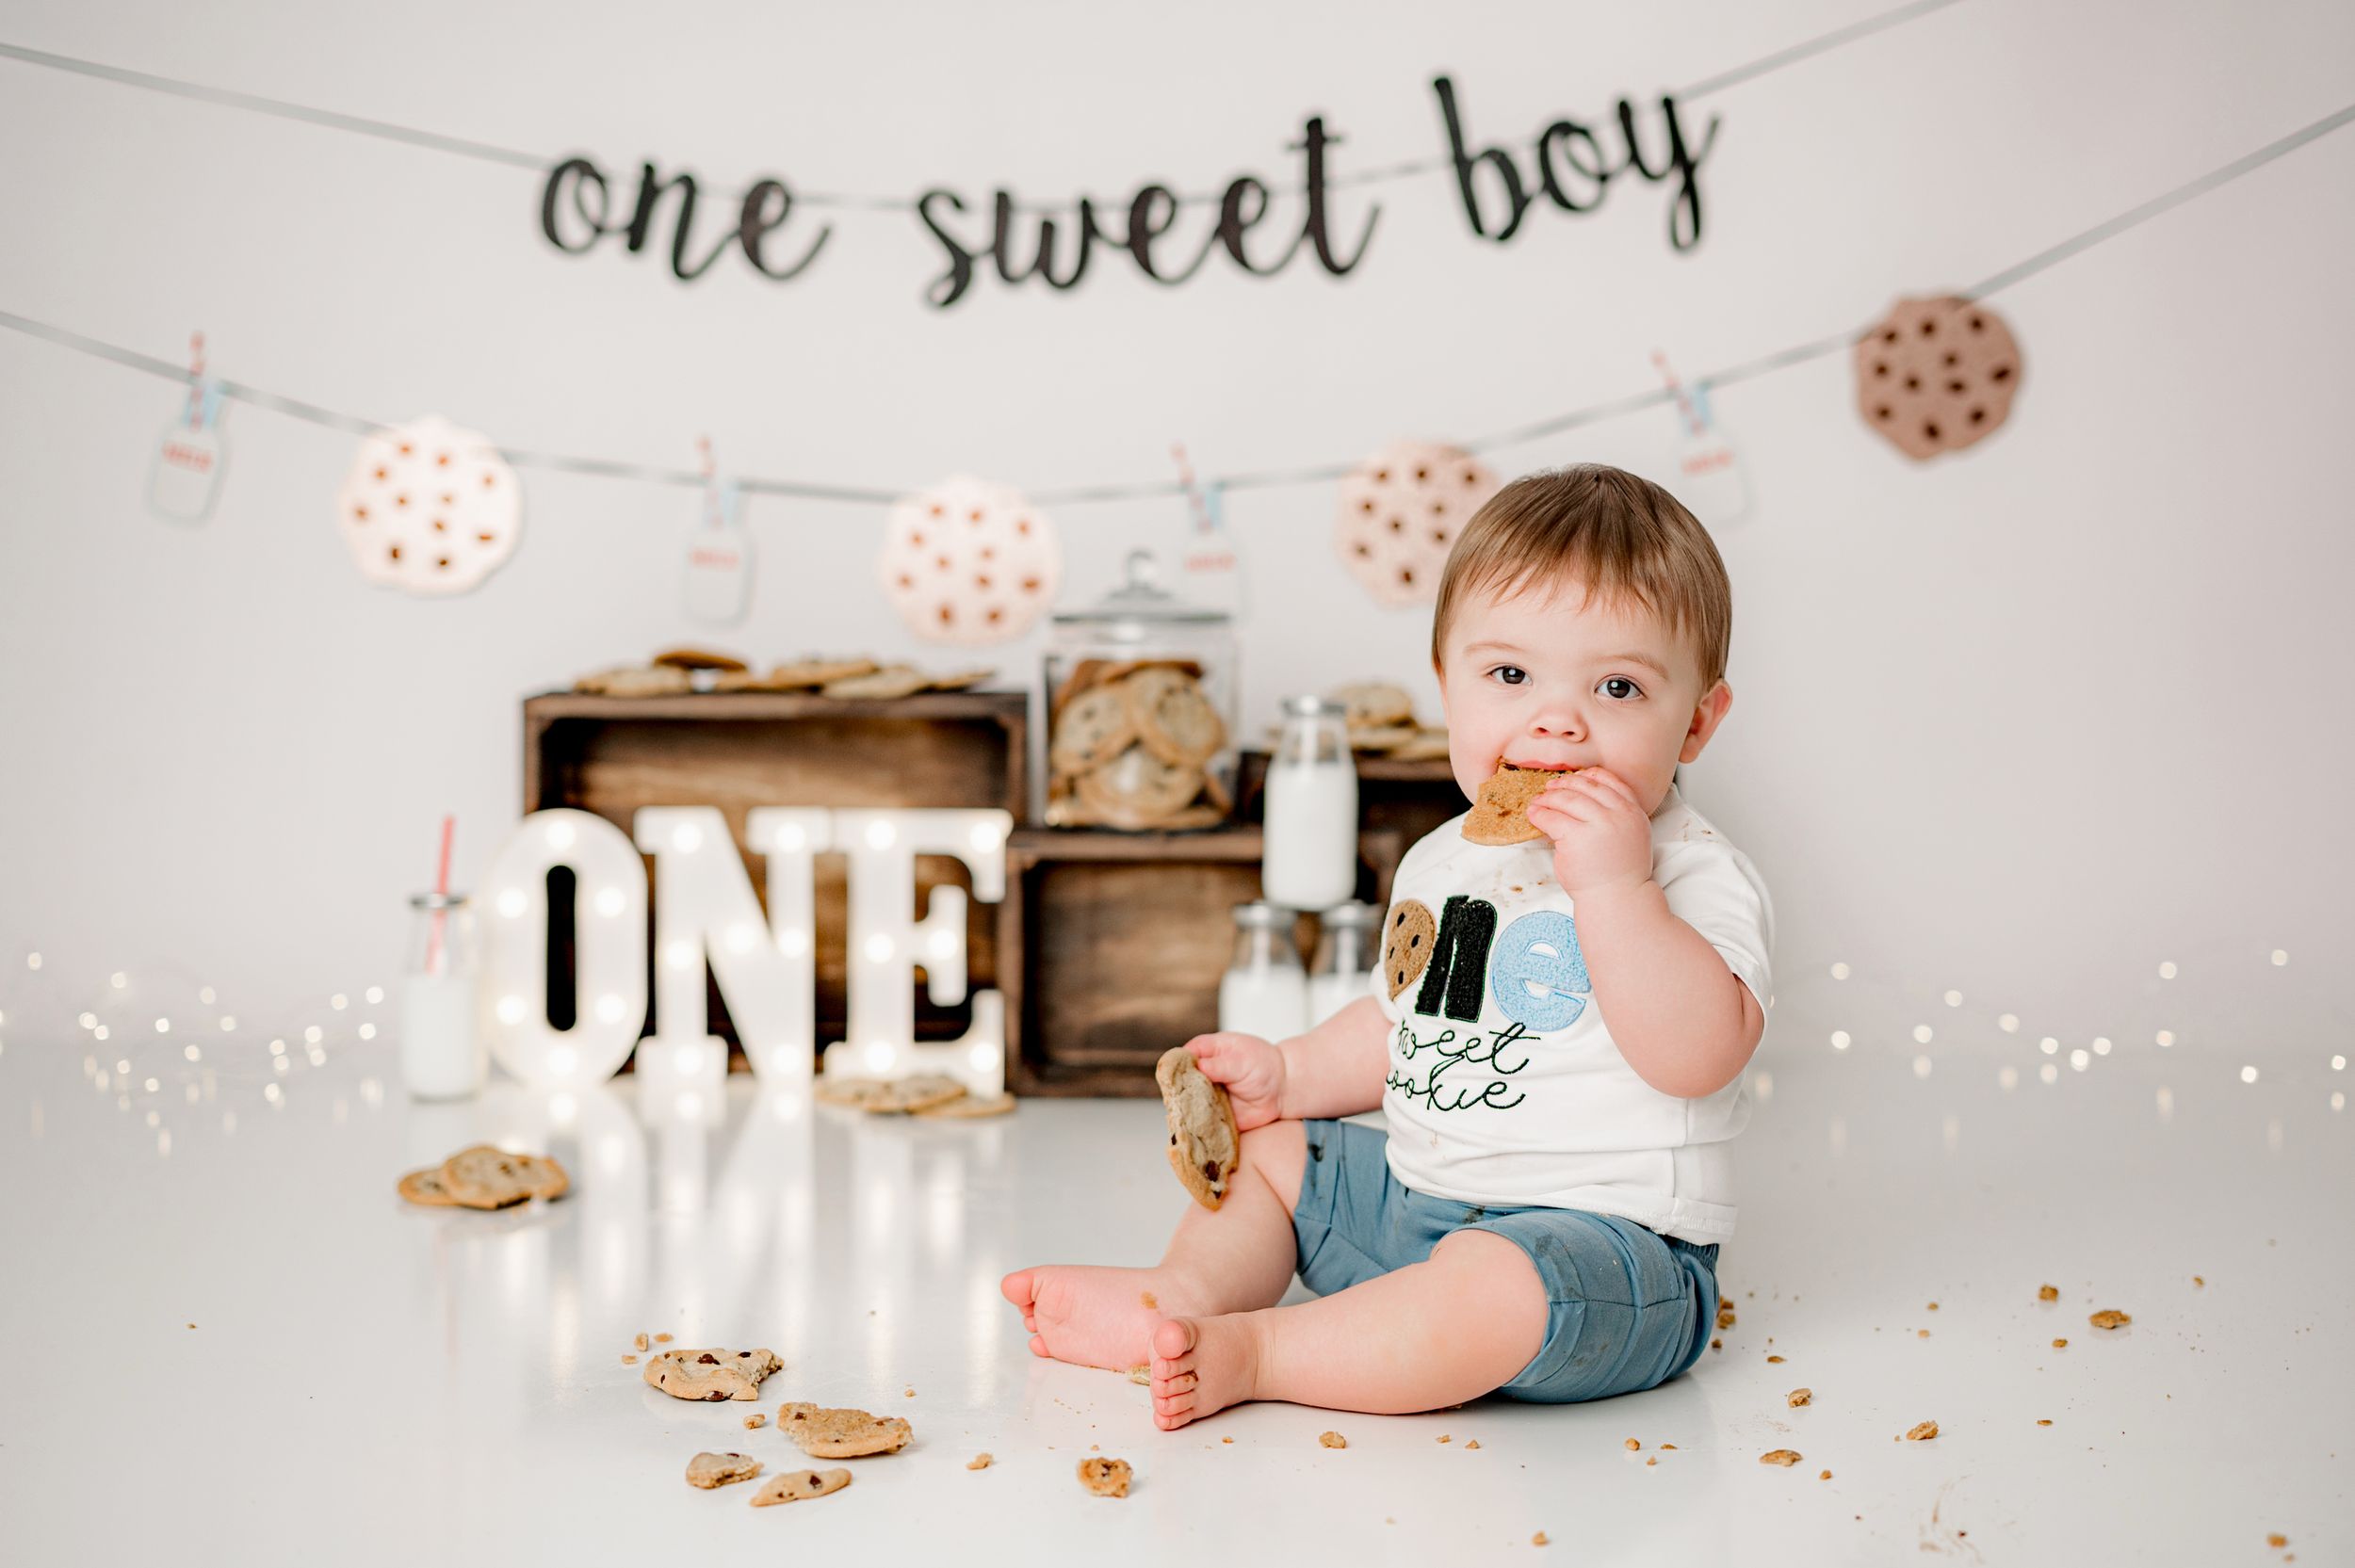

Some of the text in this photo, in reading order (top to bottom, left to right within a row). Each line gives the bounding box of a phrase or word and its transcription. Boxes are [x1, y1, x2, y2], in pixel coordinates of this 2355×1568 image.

[540, 75, 1720, 310] one sweet boy
[484, 806, 1014, 1095] ONE
[1386, 1054, 1526, 1111] ookie
[1398, 1020, 1541, 1075] weet
